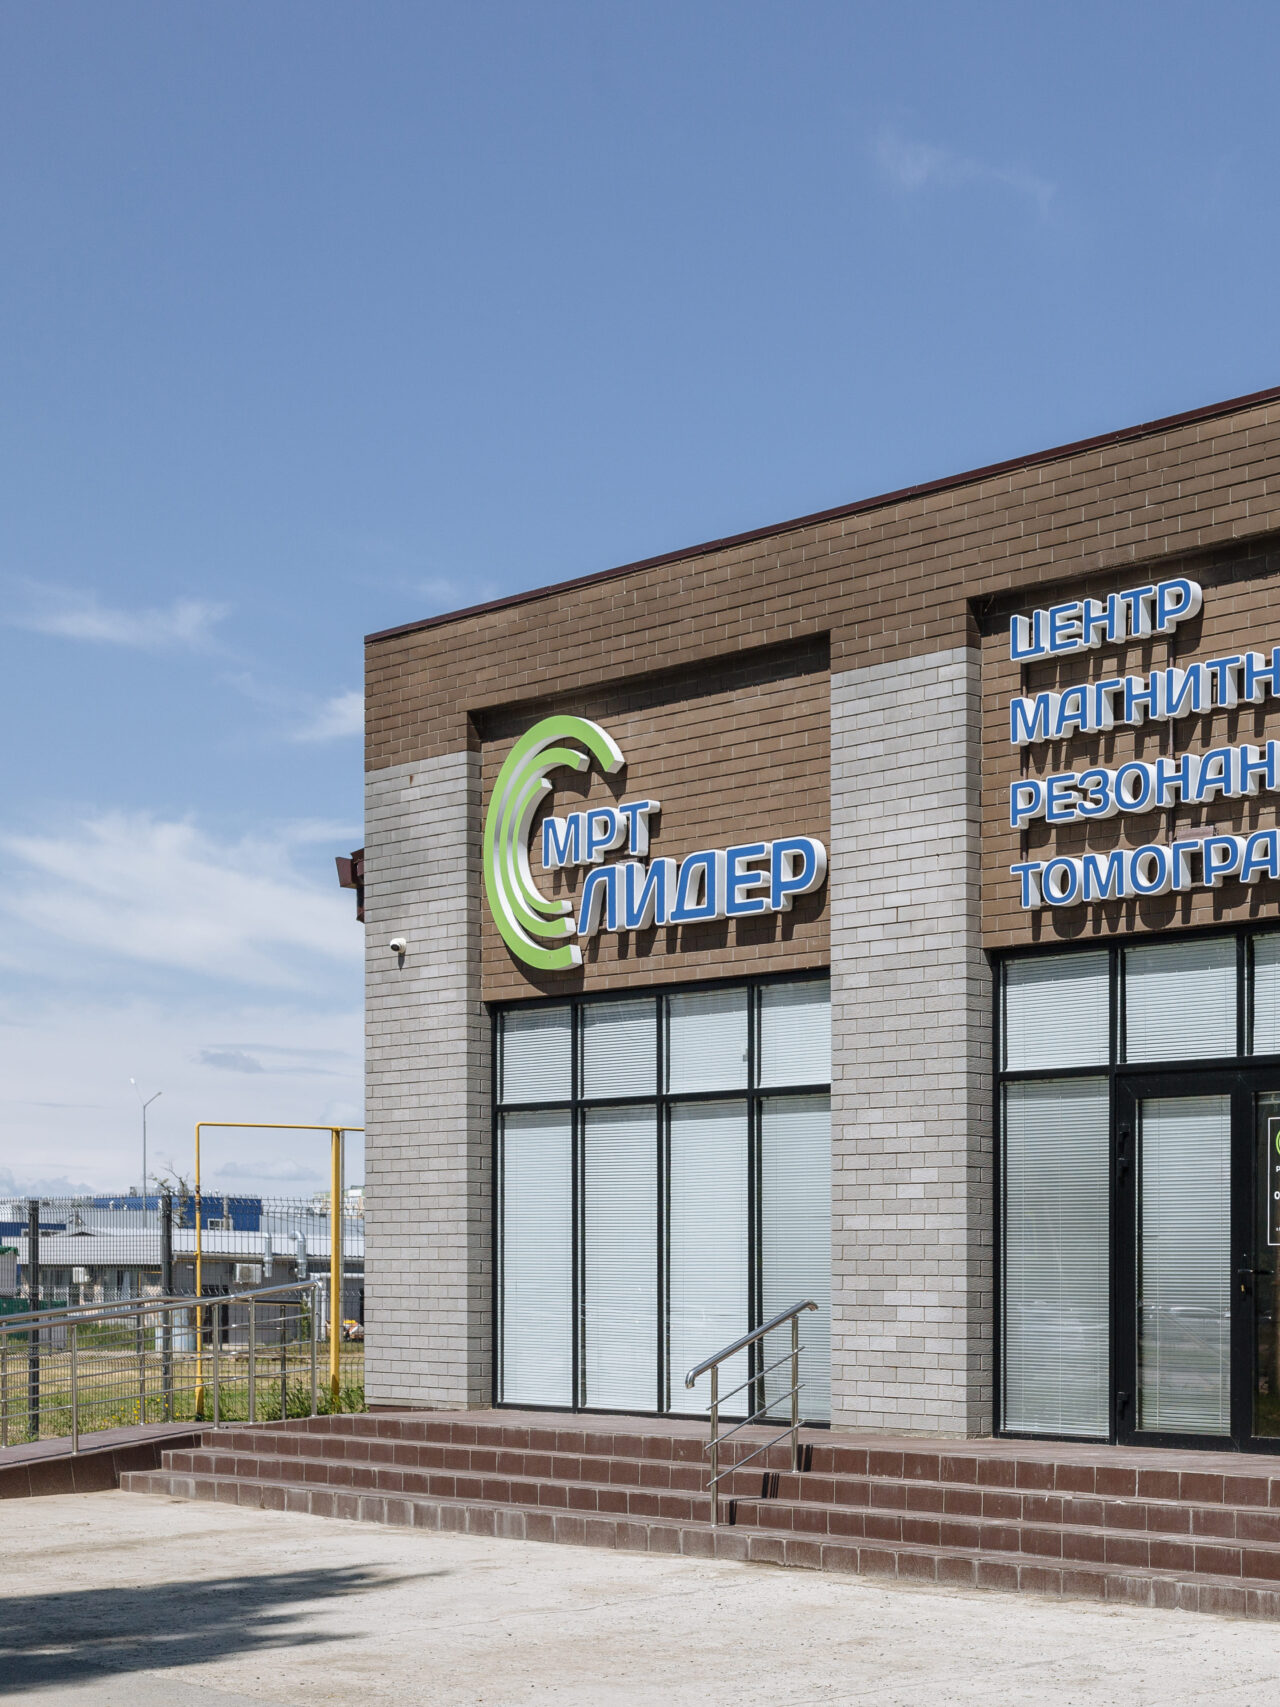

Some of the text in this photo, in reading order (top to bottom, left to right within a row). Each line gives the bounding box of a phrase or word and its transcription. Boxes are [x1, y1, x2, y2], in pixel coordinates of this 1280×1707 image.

[1010, 578, 1202, 662] ЦЕНТР
[542, 800, 660, 870] МРТ
[577, 836, 827, 936] ЛИДЕР
